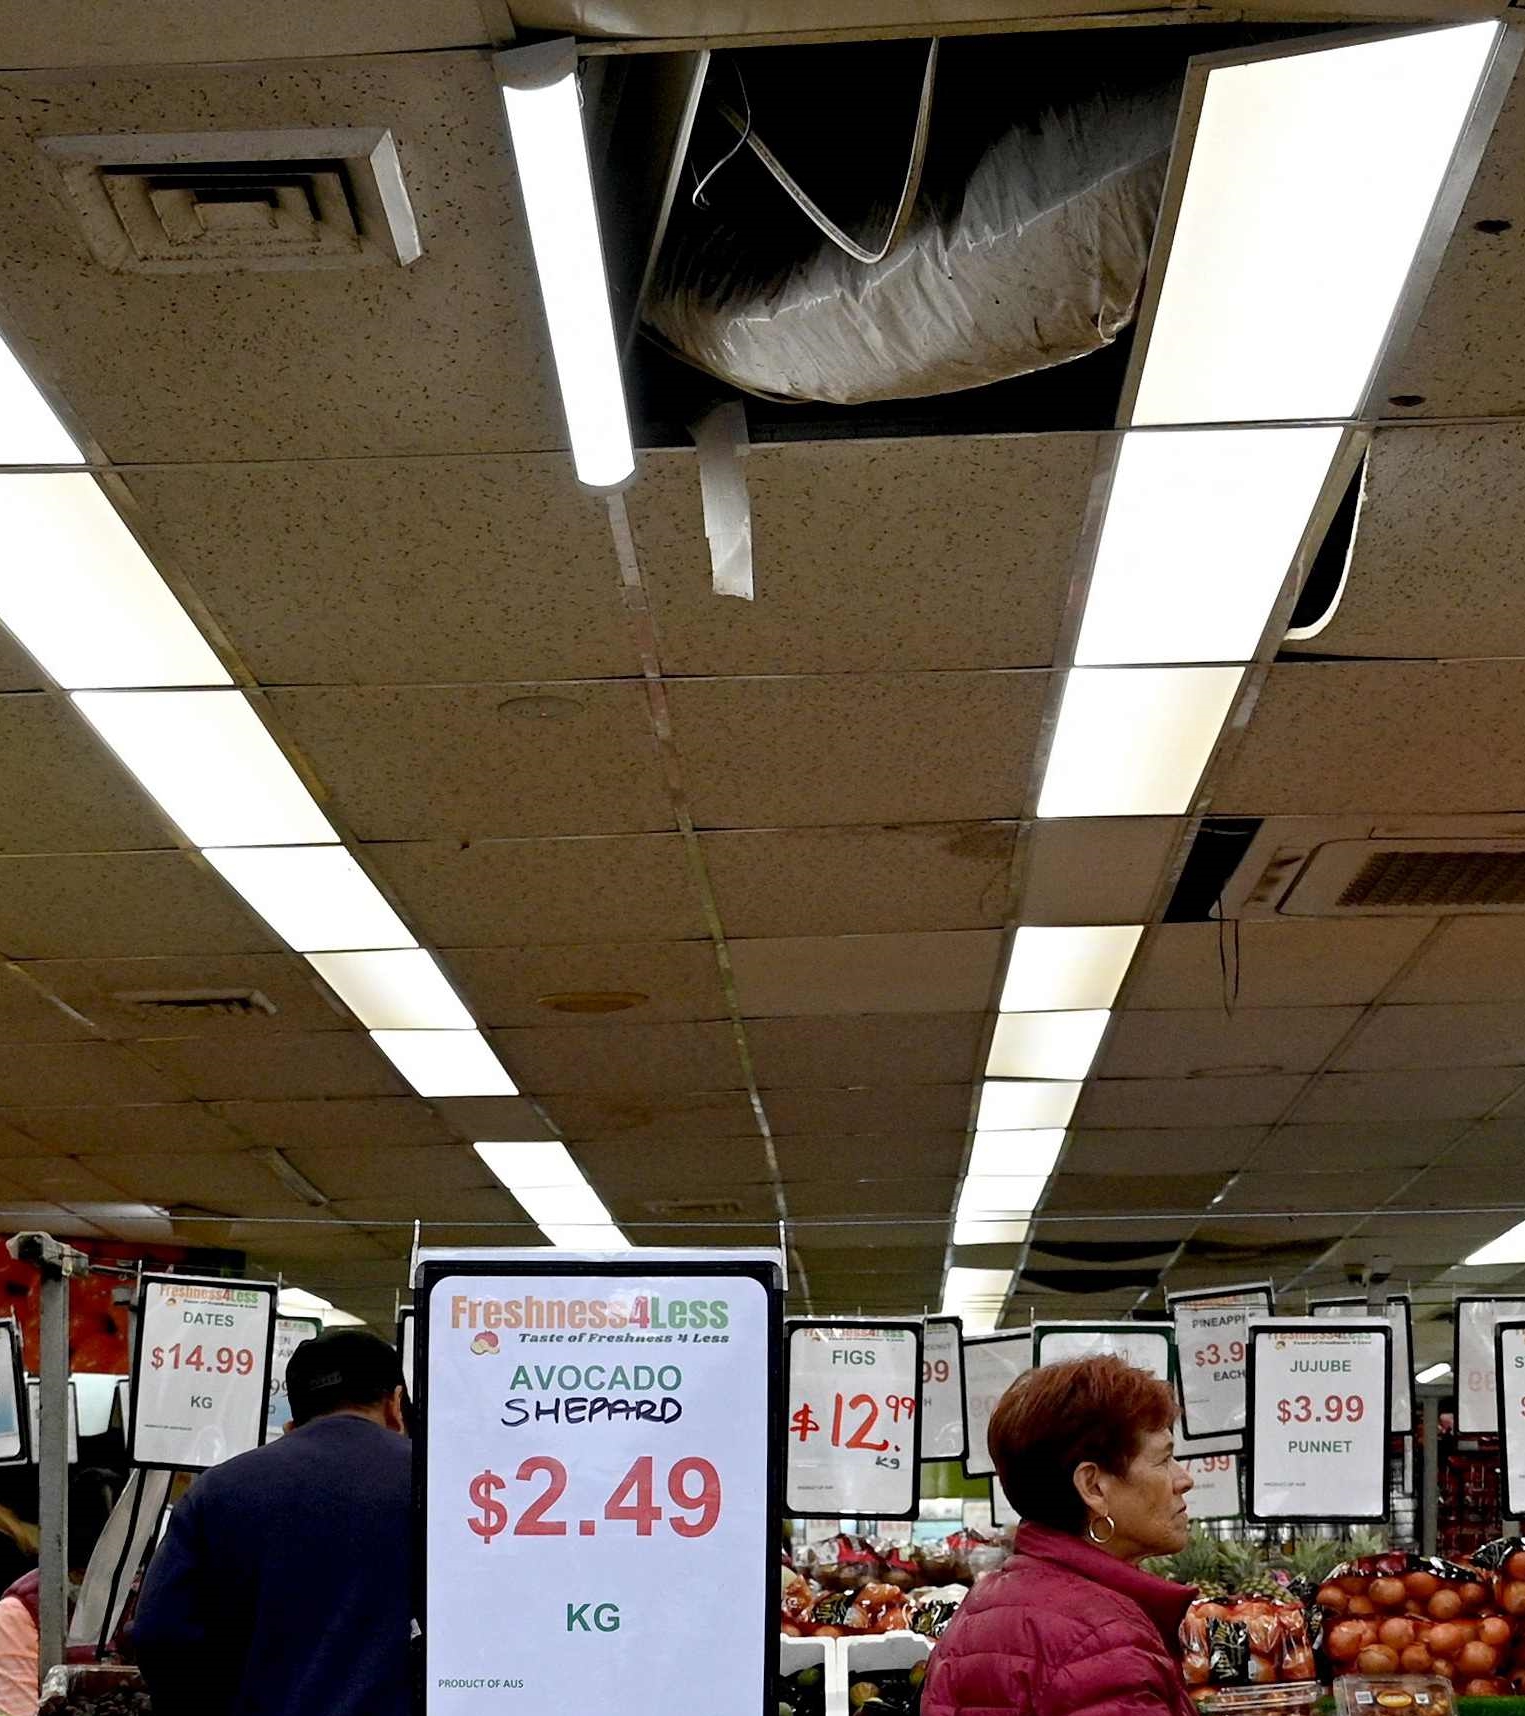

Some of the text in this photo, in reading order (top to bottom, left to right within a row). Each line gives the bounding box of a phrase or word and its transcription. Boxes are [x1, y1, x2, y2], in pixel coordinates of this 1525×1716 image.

[183, 1311, 234, 1327] DATES
[451, 1295, 729, 1329] Freshness4Less
[518, 1333, 729, 1343] Taste of Freshness 4 Less
[151, 1343, 254, 1376] $14.99
[832, 1350, 876, 1365] FIGS
[1195, 1341, 1245, 1367] $3.9
[1290, 1360, 1352, 1373] JUJUBE
[510, 1365, 683, 1391] AVOCADO
[190, 1396, 213, 1409] KG
[501, 1396, 683, 1428] SHEPARD
[1277, 1395, 1365, 1425] $3.99
[1288, 1440, 1352, 1453] PUNNET
[467, 1455, 722, 1544] $2.49
[566, 1603, 621, 1632] KG
[438, 1678, 524, 1689] PRODUCT OF AUS
